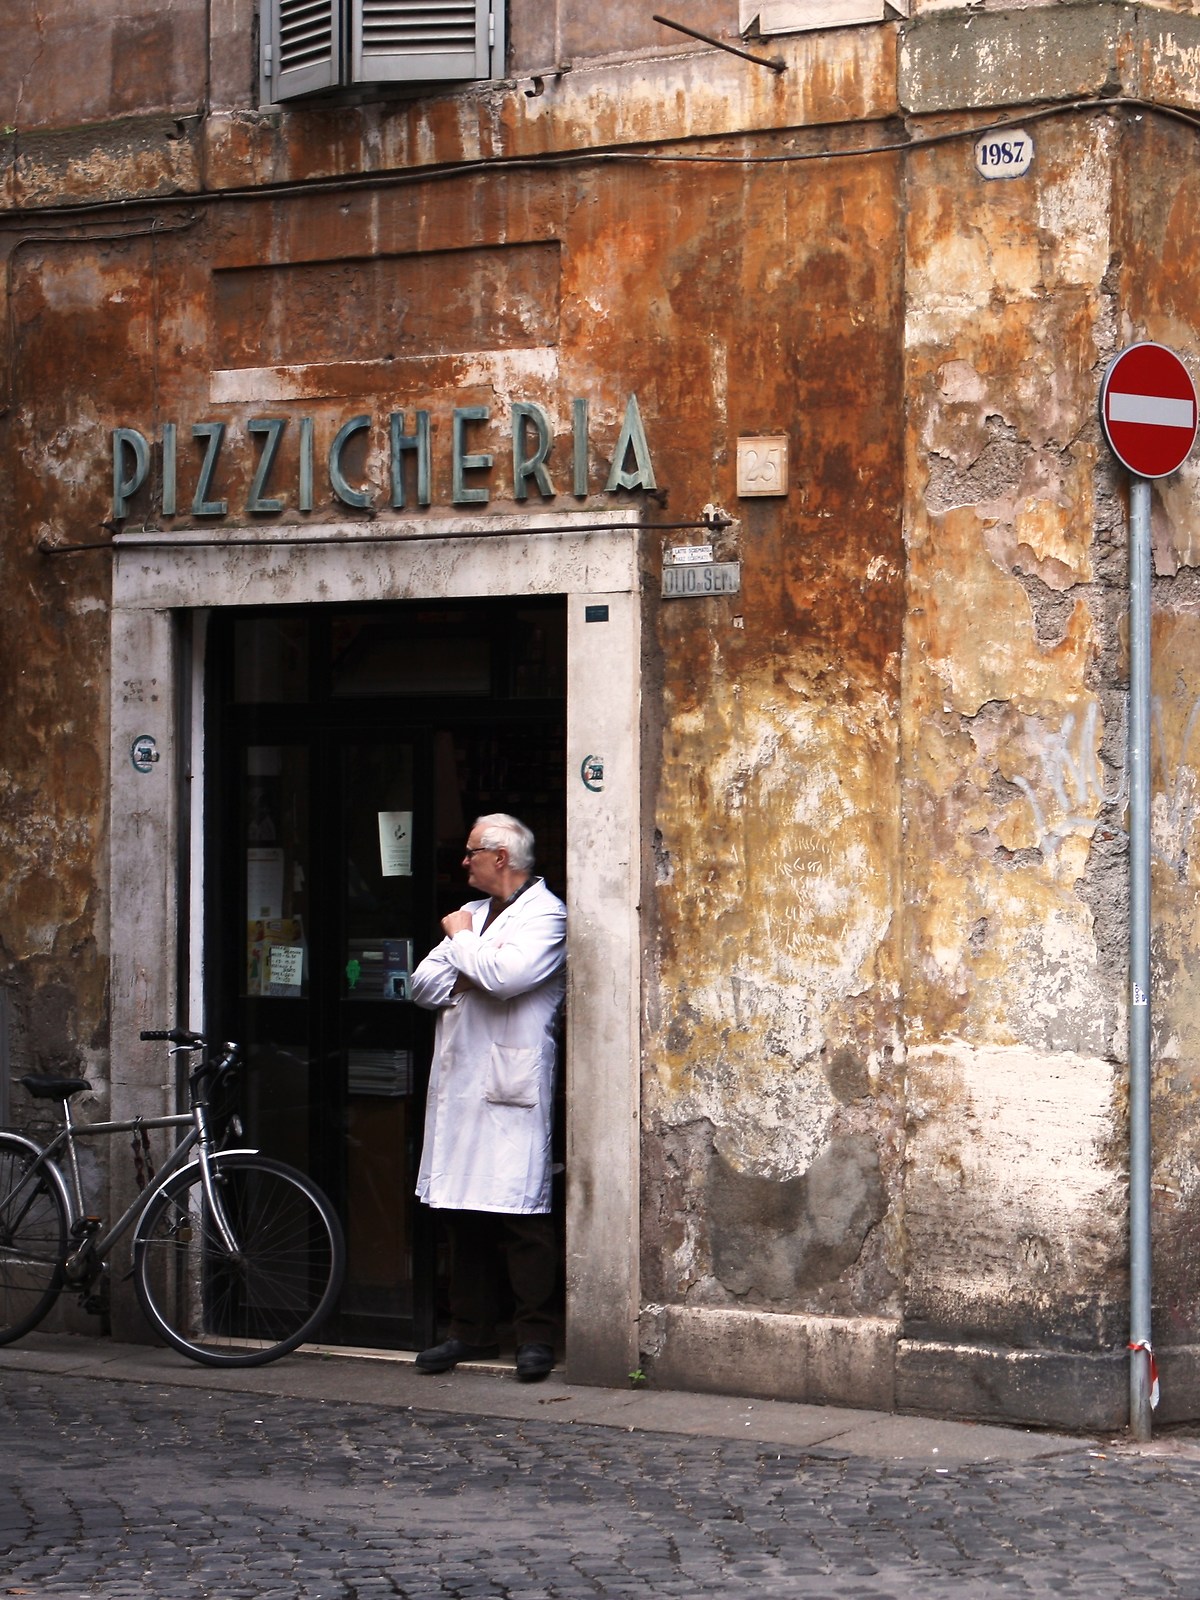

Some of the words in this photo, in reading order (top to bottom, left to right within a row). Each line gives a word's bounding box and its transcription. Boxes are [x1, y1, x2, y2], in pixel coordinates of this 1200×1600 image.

[981, 141, 1025, 166] 1987
[112, 392, 658, 520] PIZZICHERIA
[744, 448, 779, 482] 25
[665, 568, 696, 594] OLIO
